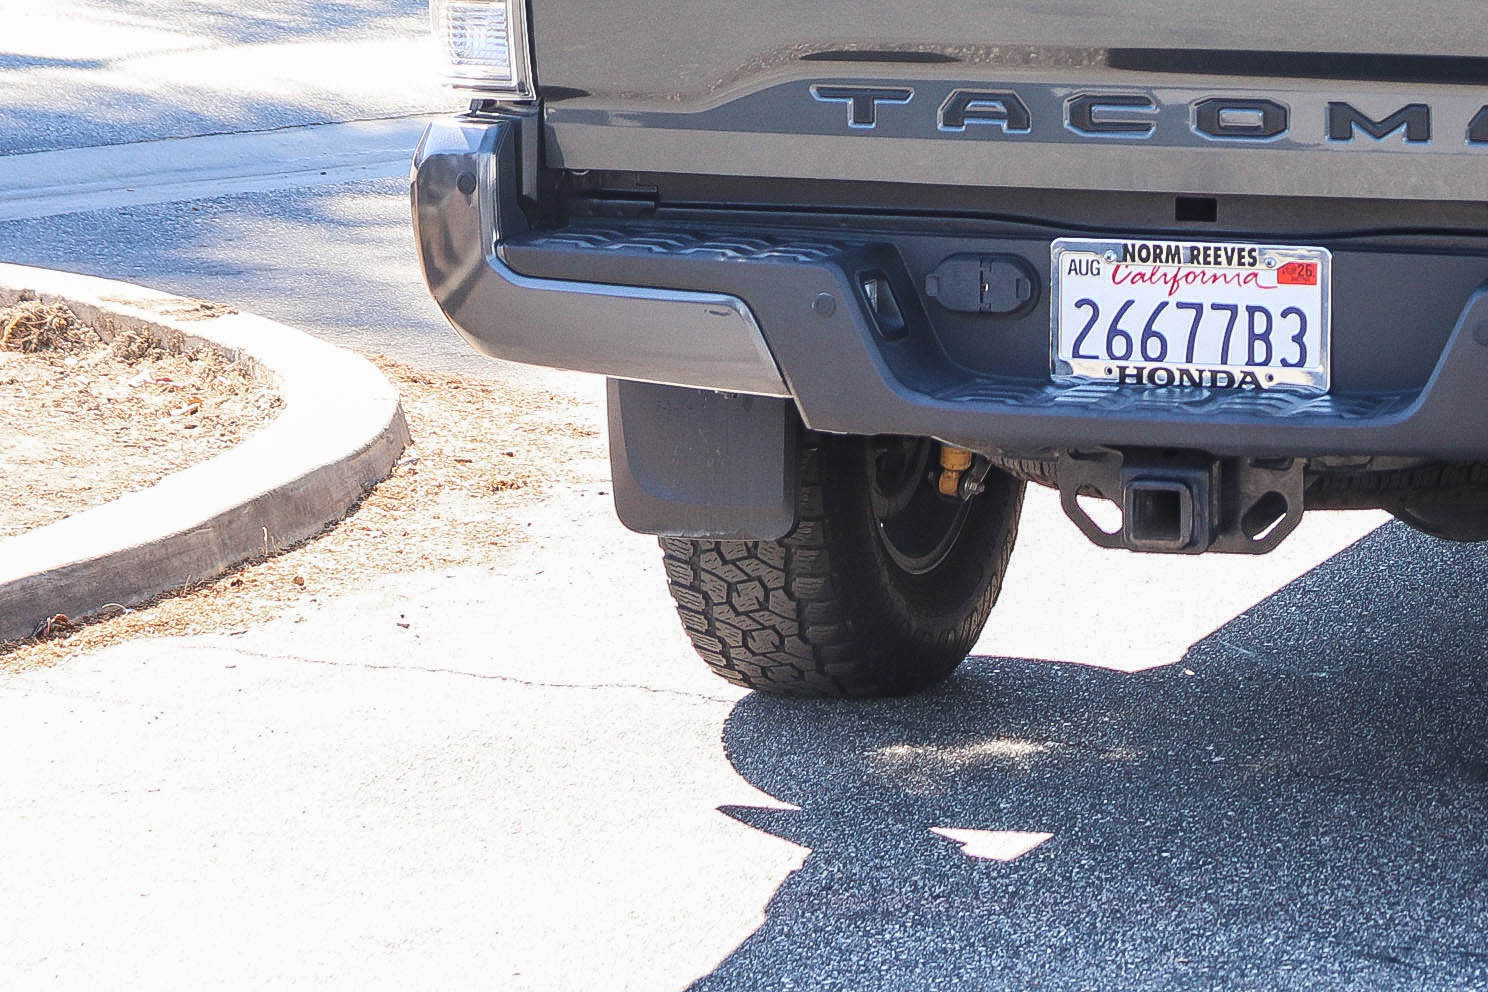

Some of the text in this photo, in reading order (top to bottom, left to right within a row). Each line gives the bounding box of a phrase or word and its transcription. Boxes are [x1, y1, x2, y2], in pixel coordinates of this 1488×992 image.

[1067, 258, 1101, 277] AUG
[1121, 243, 1258, 268] NORM REEVES
[1111, 264, 1278, 297] California
[1071, 298, 1309, 369] 26677B3
[1115, 365, 1264, 391] HONDA
